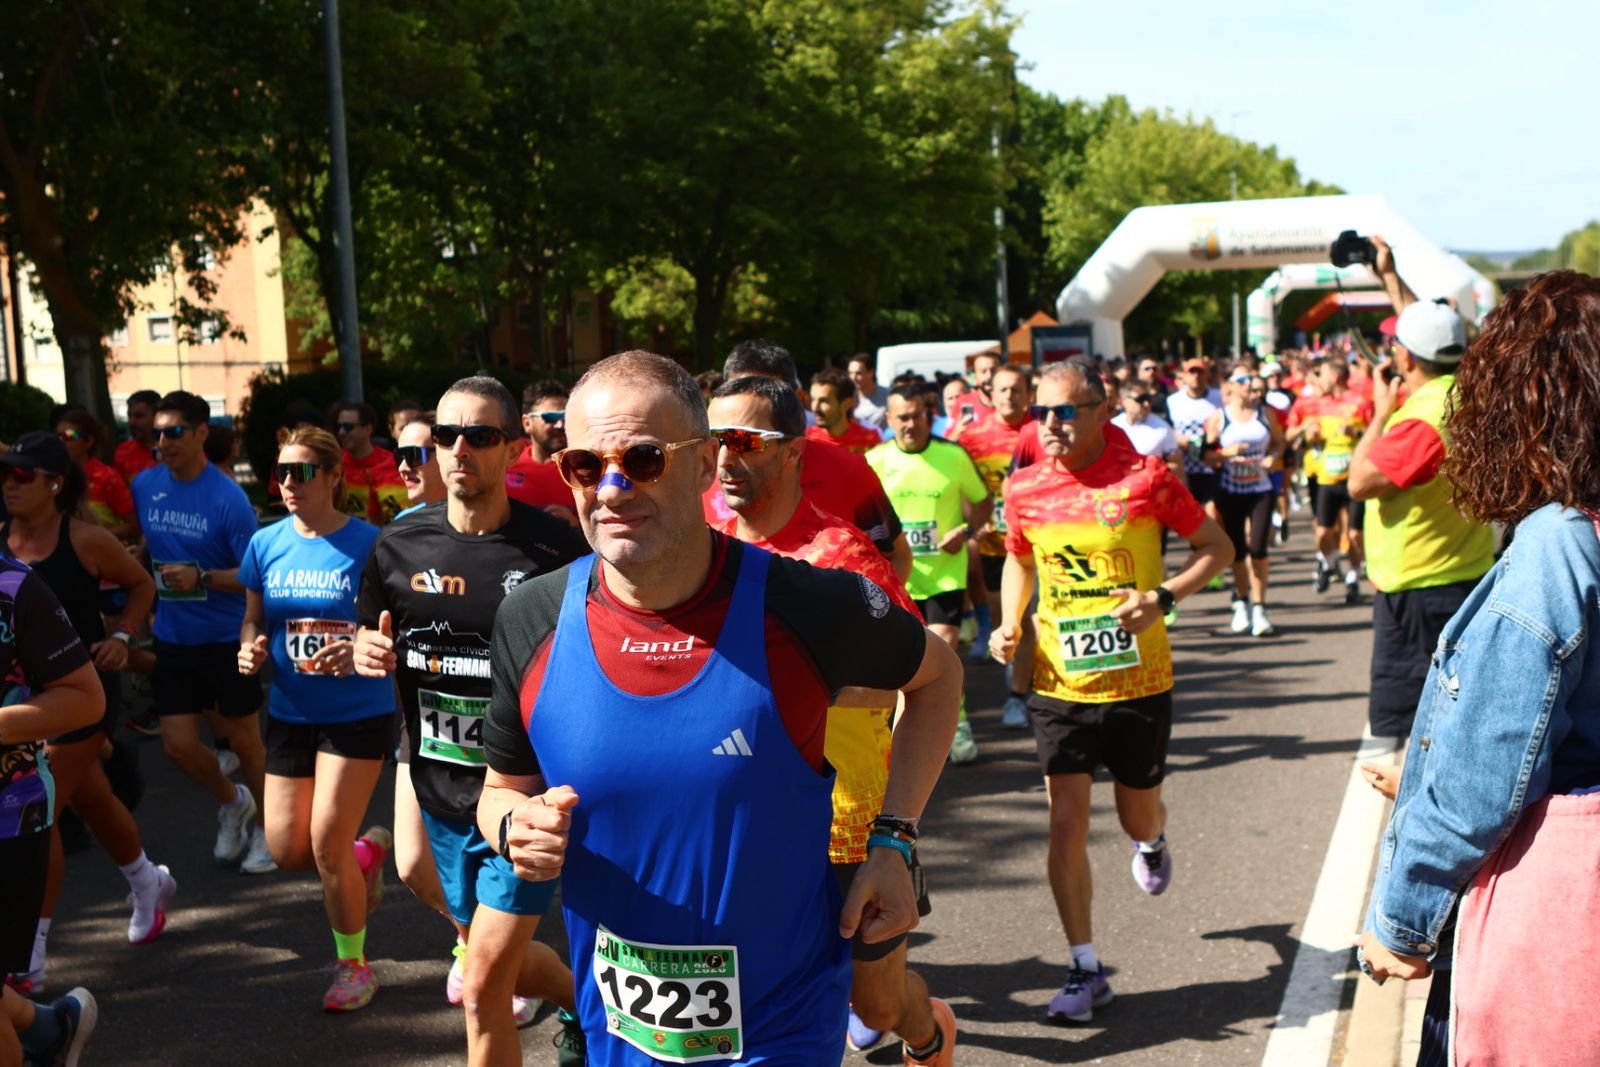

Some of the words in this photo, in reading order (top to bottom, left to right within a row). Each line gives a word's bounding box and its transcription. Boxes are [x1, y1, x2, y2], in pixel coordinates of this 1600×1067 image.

[148, 508, 159, 522] LA
[162, 510, 208, 532] ARMUÑA
[268, 570, 280, 588] LA
[284, 568, 351, 592] ARMUÑA
[270, 588, 290, 599] CLUB
[292, 588, 344, 600] DEPORTIVO
[289, 634, 352, 658] 16
[620, 635, 695, 653] land
[1064, 627, 1132, 657] 1209
[407, 649, 427, 671] SAN
[645, 653, 692, 661] EVENTS
[622, 944, 645, 960] SAN
[622, 955, 691, 974] CARRERA
[600, 965, 732, 1029] 1223
